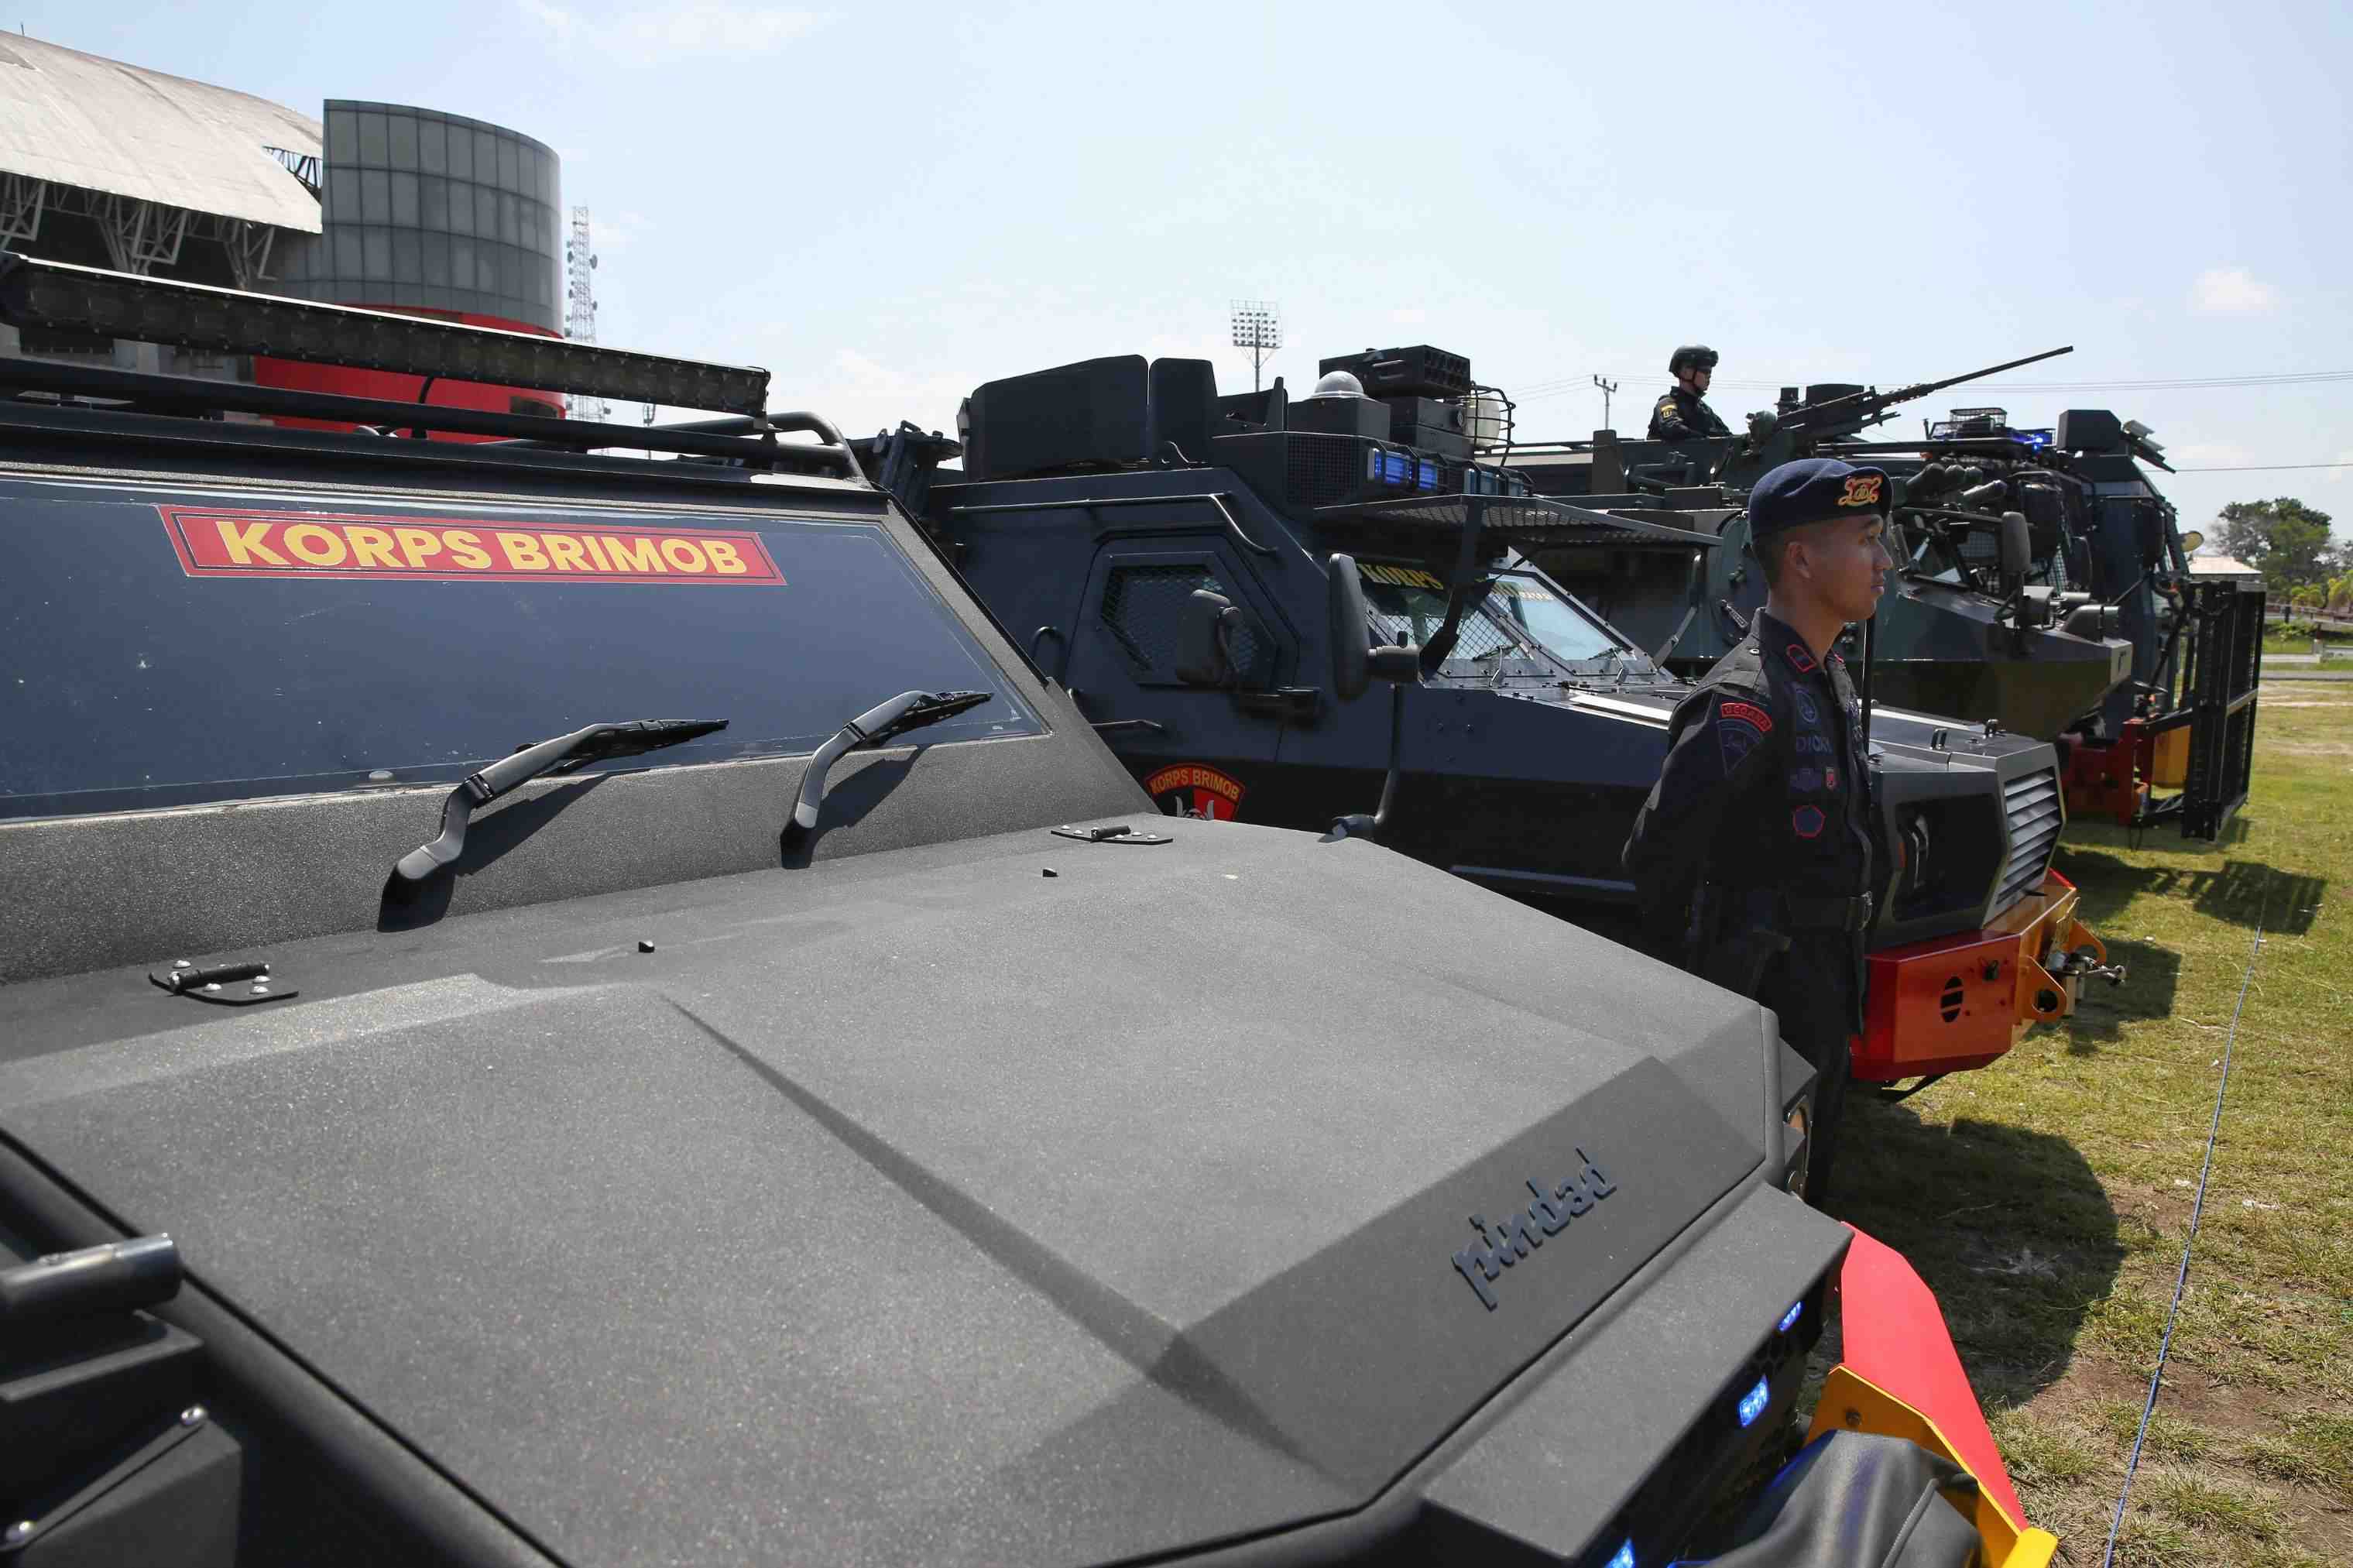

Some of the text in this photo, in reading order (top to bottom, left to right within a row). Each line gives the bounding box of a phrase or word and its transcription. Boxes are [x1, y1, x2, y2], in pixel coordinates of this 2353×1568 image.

[214, 520, 748, 574] KORPS BRIMOB
[1150, 769, 1240, 800] KORPS BRIMOB
[1450, 1147, 1617, 1312] pindad
